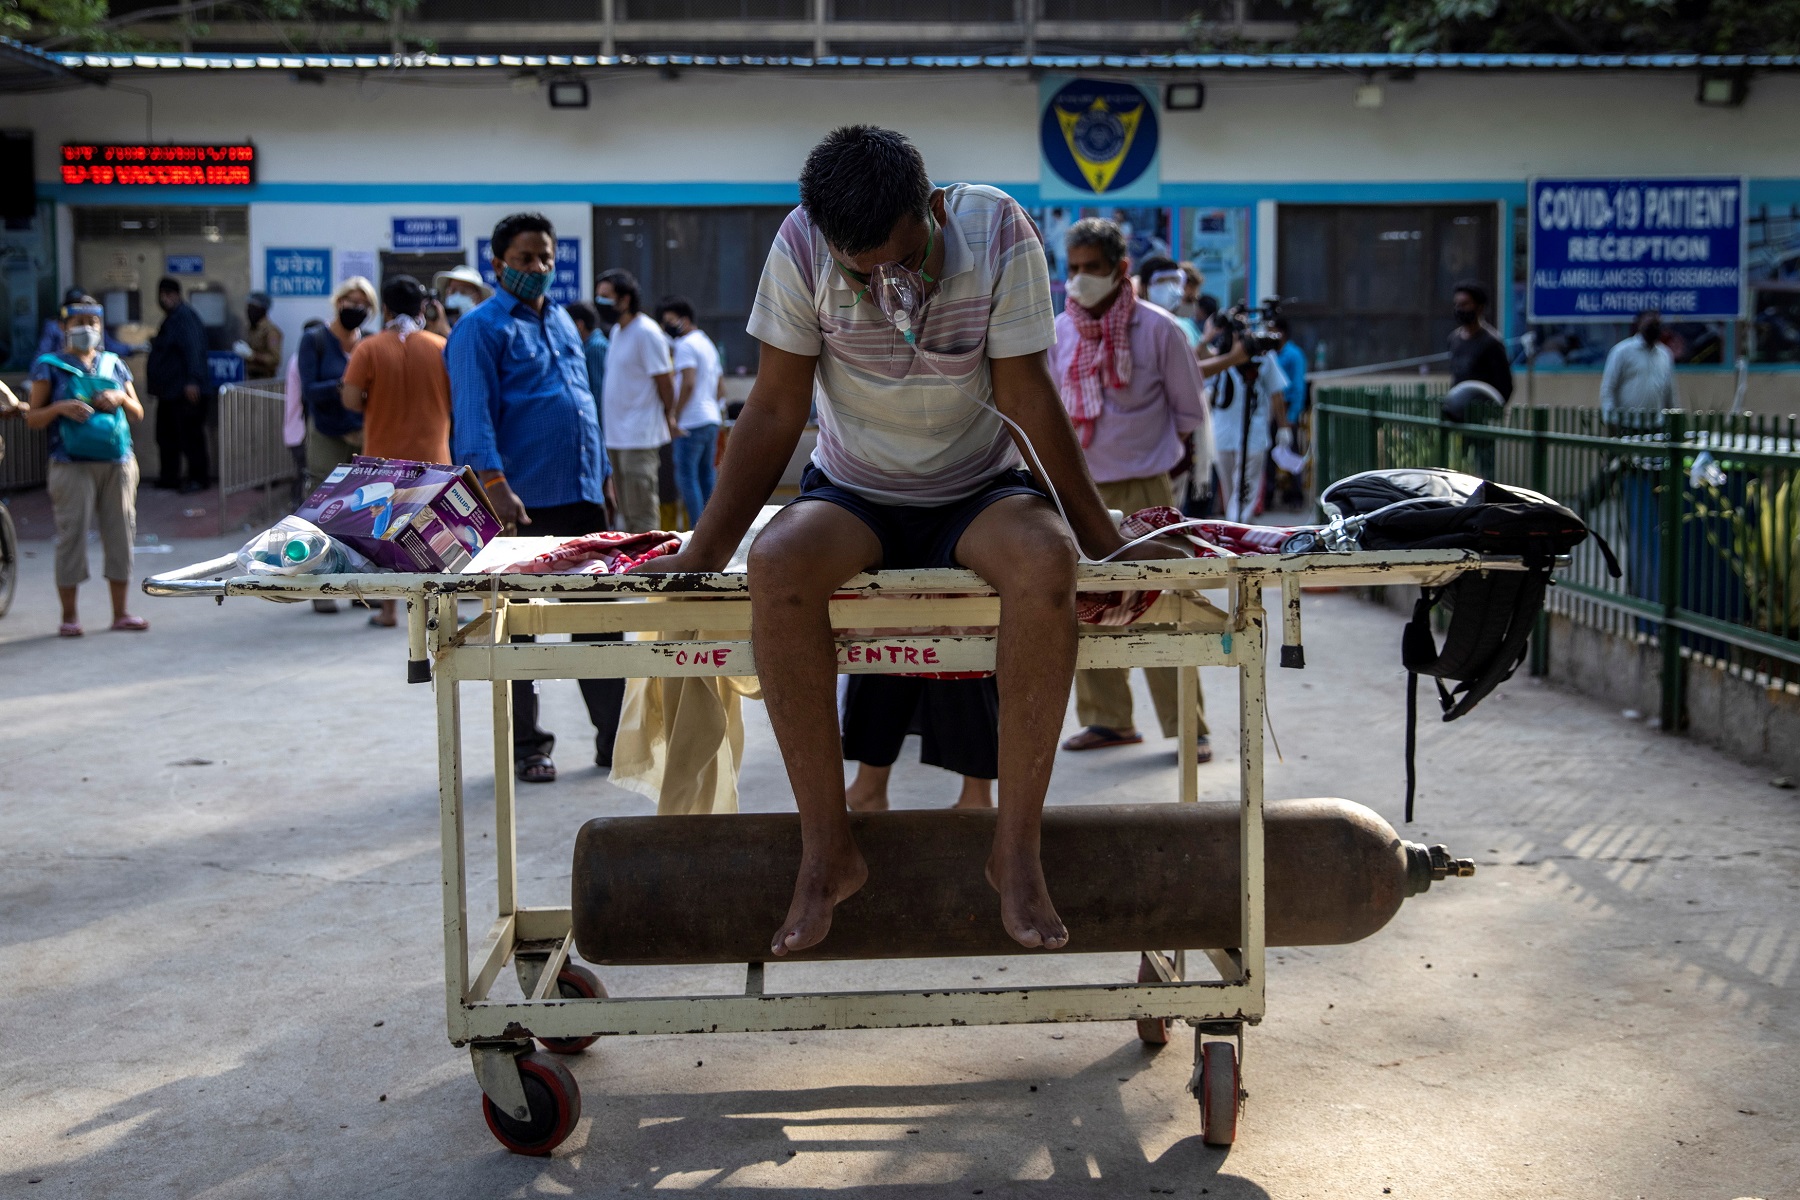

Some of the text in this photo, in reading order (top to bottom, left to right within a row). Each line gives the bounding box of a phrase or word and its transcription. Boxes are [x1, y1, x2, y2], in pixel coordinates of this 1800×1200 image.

[1538, 187, 1739, 230] COVID-19 PATIENT
[1567, 236, 1710, 262] RECEPTION
[270, 276, 325, 294] ENTRY
[1534, 267, 1739, 288] ALL AMBULANCES TO DISEMBARK
[1575, 291, 1697, 312] ALL PATIENTS HERE
[451, 488, 472, 512] PHILIPS
[676, 648, 732, 668] ONE
